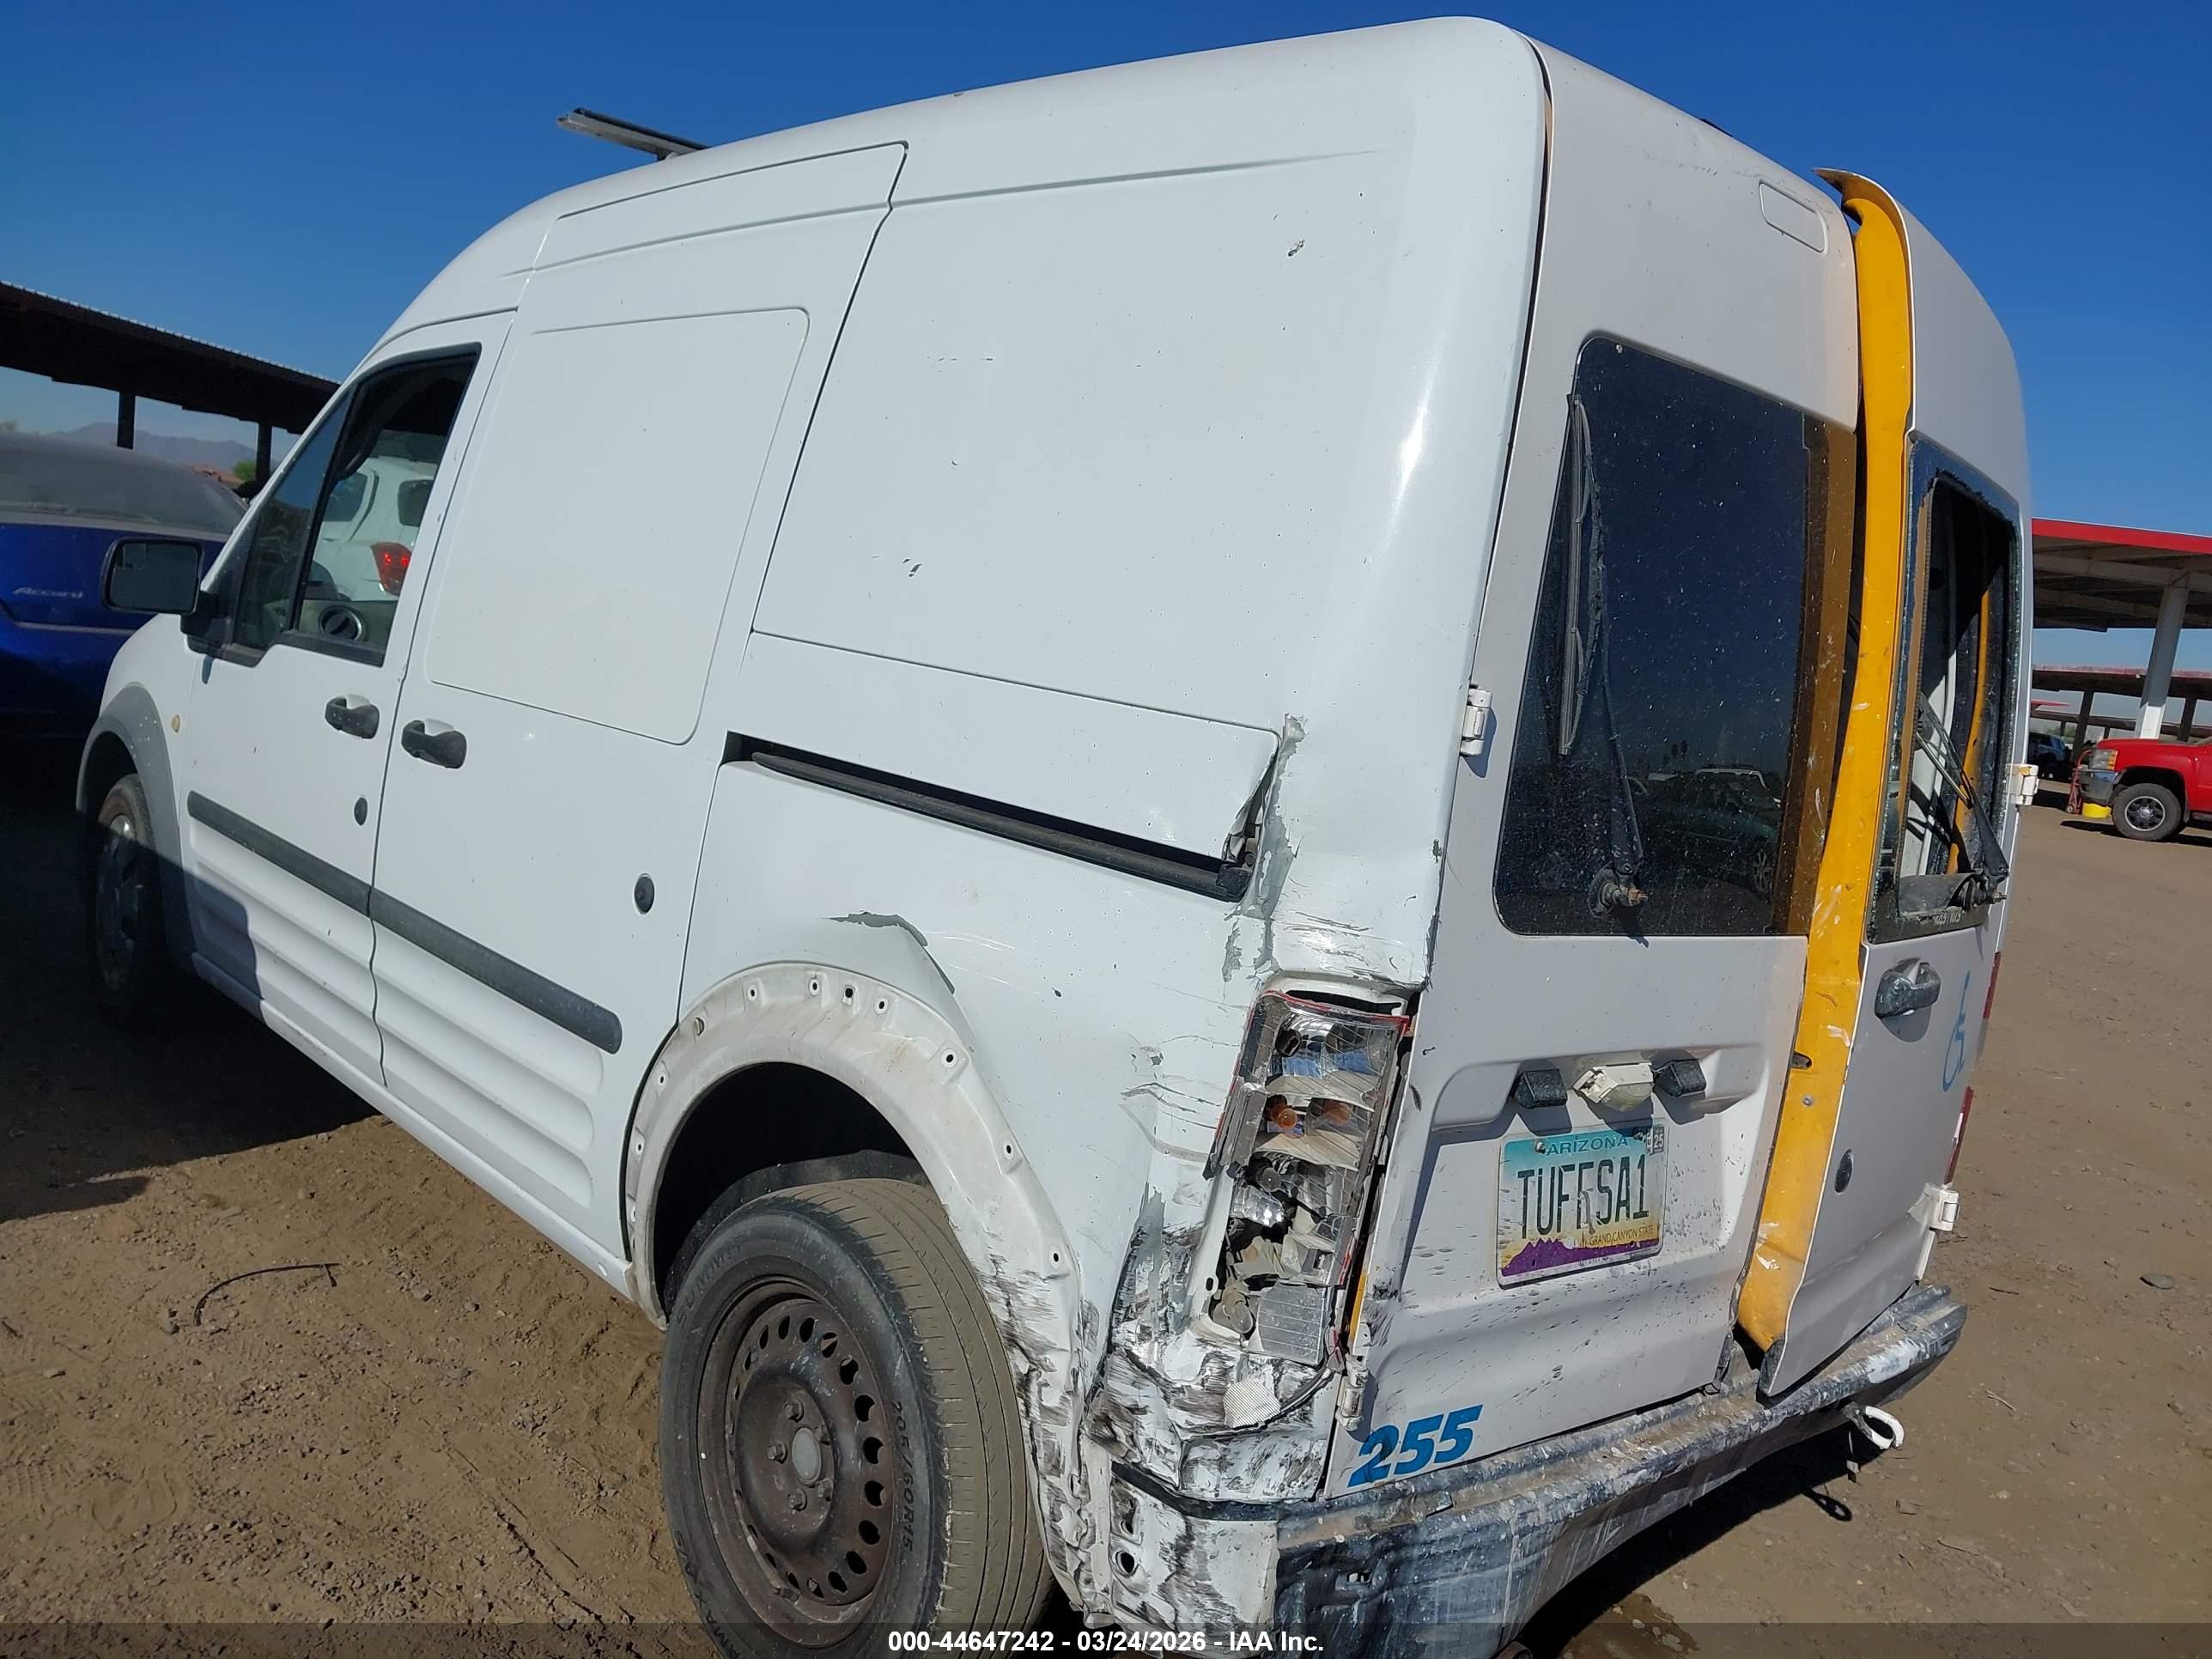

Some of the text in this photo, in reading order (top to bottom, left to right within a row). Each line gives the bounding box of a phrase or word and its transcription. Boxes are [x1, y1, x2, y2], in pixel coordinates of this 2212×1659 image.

[1547, 1135, 1628, 1156] ARIZONA
[1654, 1133, 1663, 1149] 25
[1589, 1225, 1654, 1245] GRAND CANYON STATE
[1347, 1404, 1484, 1487] 255
[892, 1401, 915, 1552] 205/60R15
